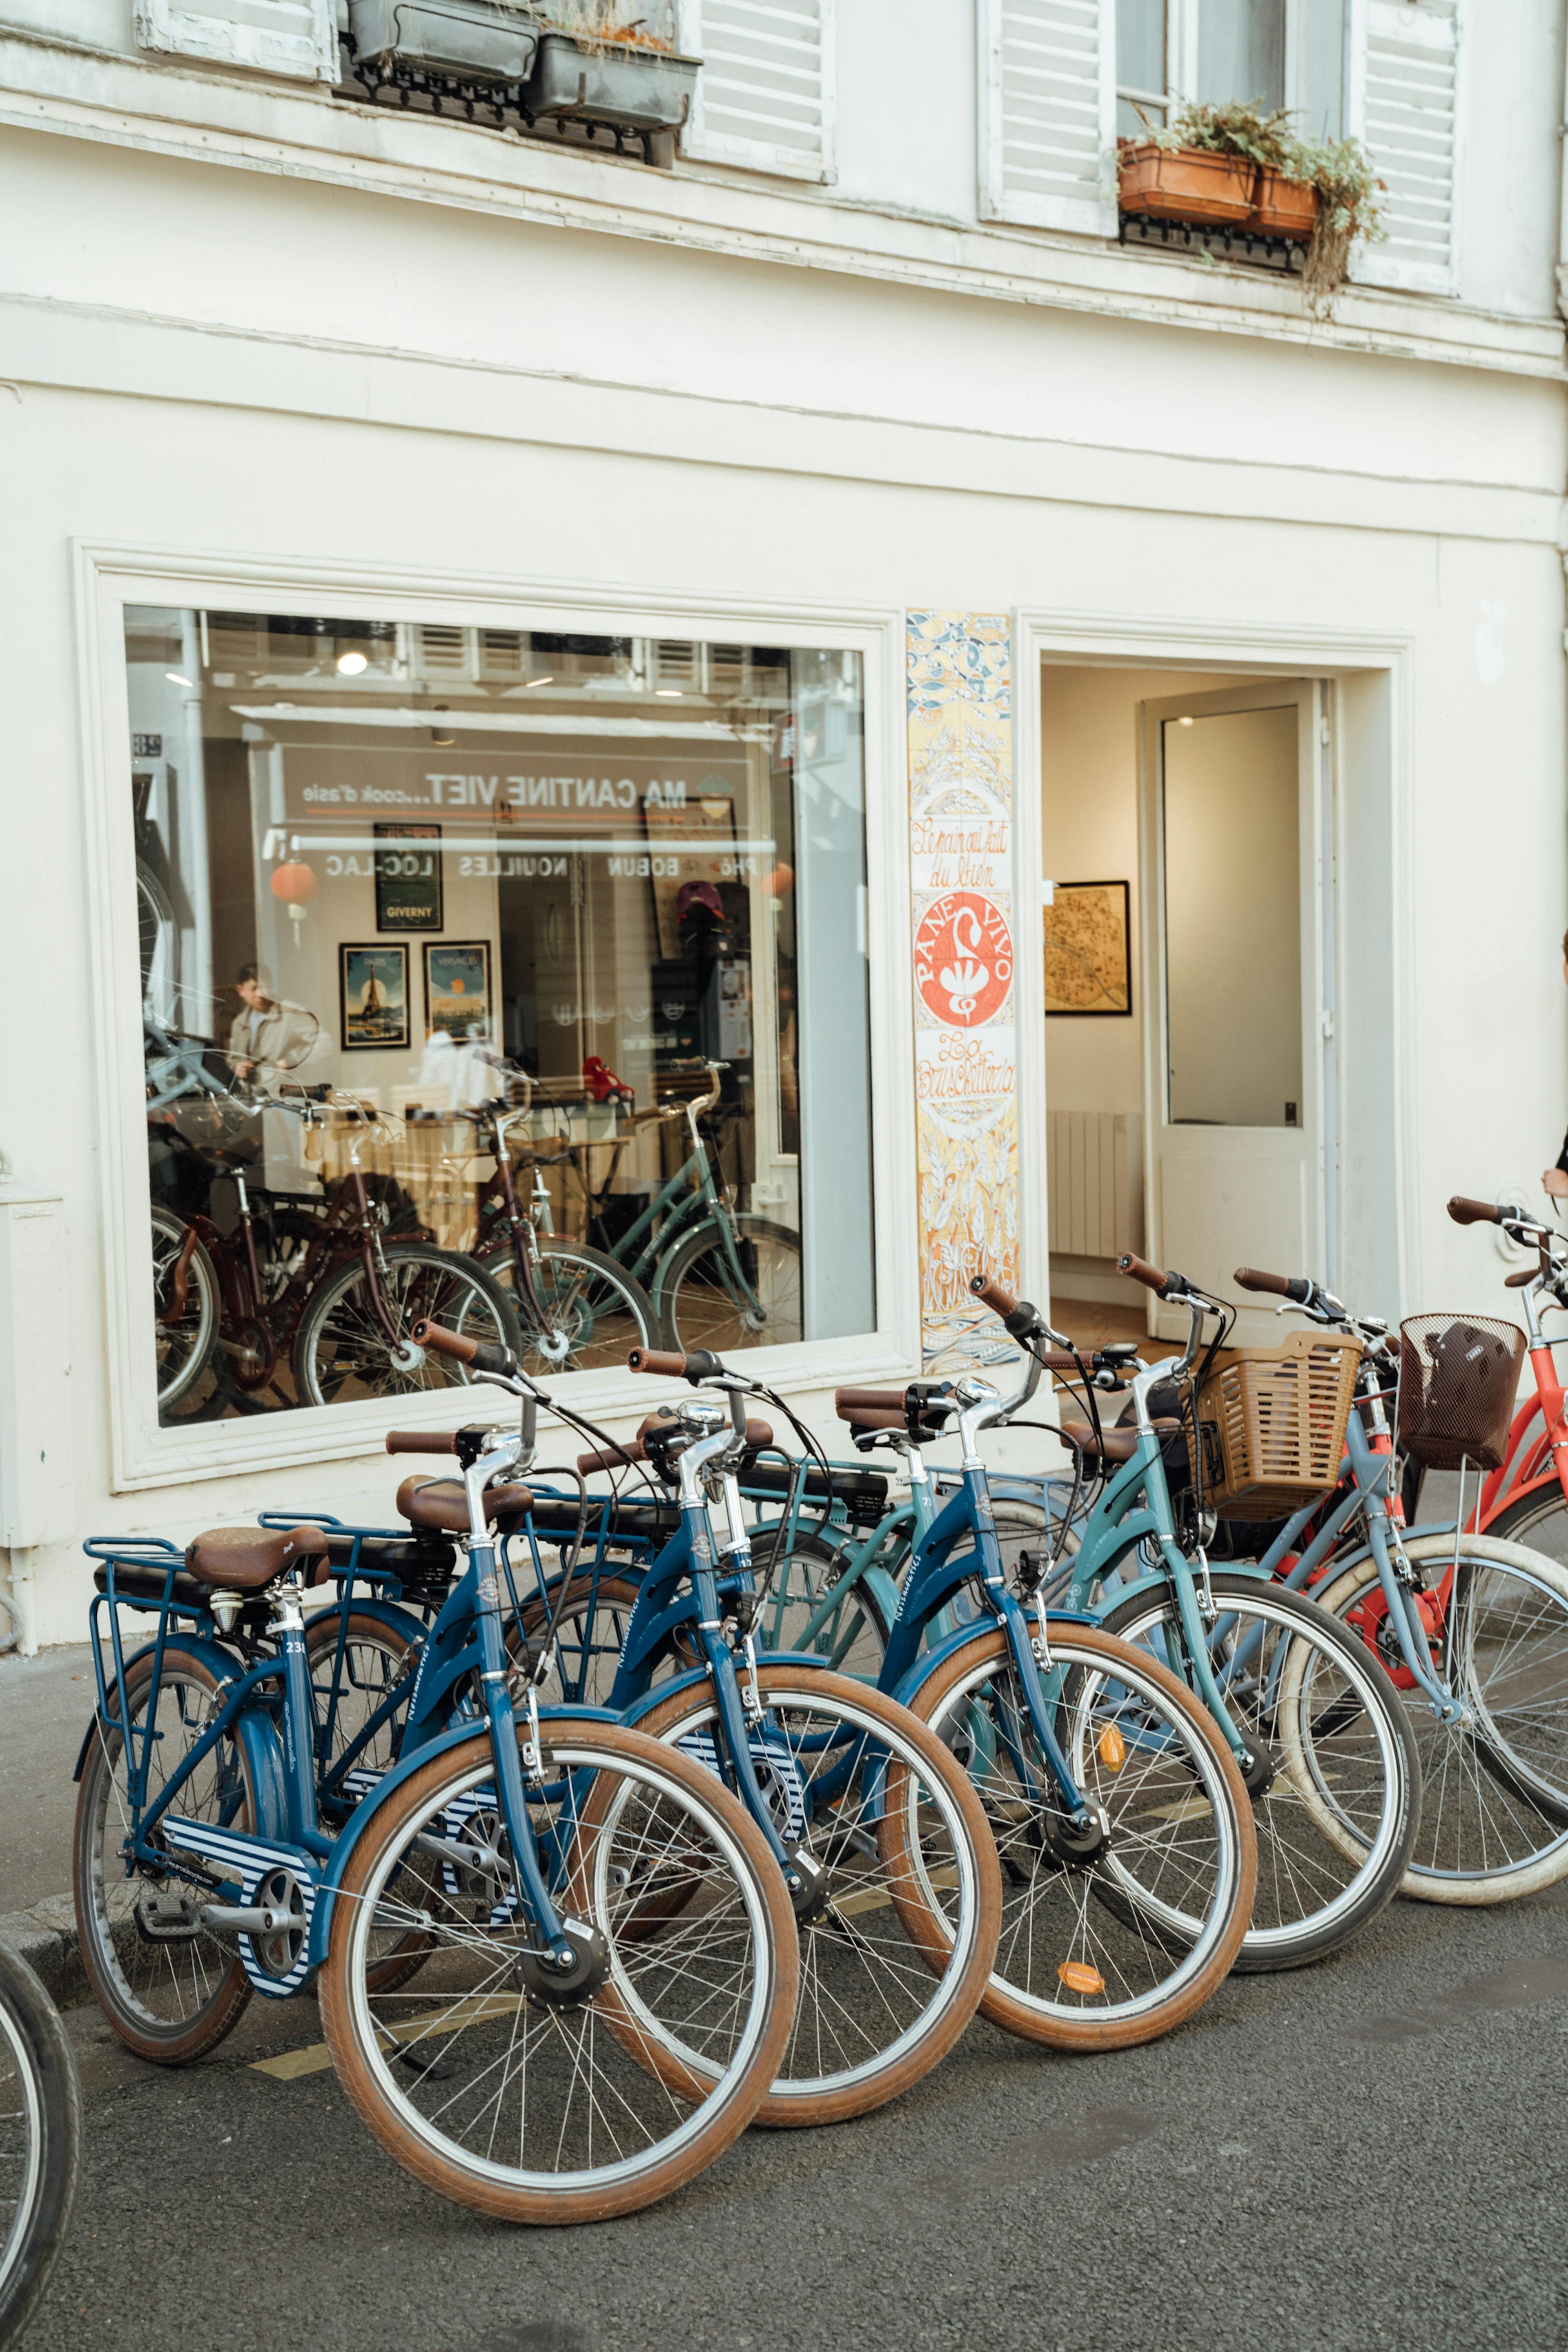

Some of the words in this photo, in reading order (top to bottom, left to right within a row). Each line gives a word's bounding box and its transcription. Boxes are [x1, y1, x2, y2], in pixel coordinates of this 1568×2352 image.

[912, 817, 934, 855] Le
[933, 826, 964, 869] pain
[982, 820, 1009, 866] fait
[929, 857, 951, 888] du
[953, 855, 996, 888] bien
[386, 906, 433, 918] GIVERNY
[916, 895, 957, 990] PANE
[982, 902, 1012, 982] VIVO
[364, 958, 386, 967] PARIS
[438, 957, 478, 966] VERSAILLES
[938, 1031, 994, 1061] La
[916, 1057, 1017, 1099] Bruschetteria
